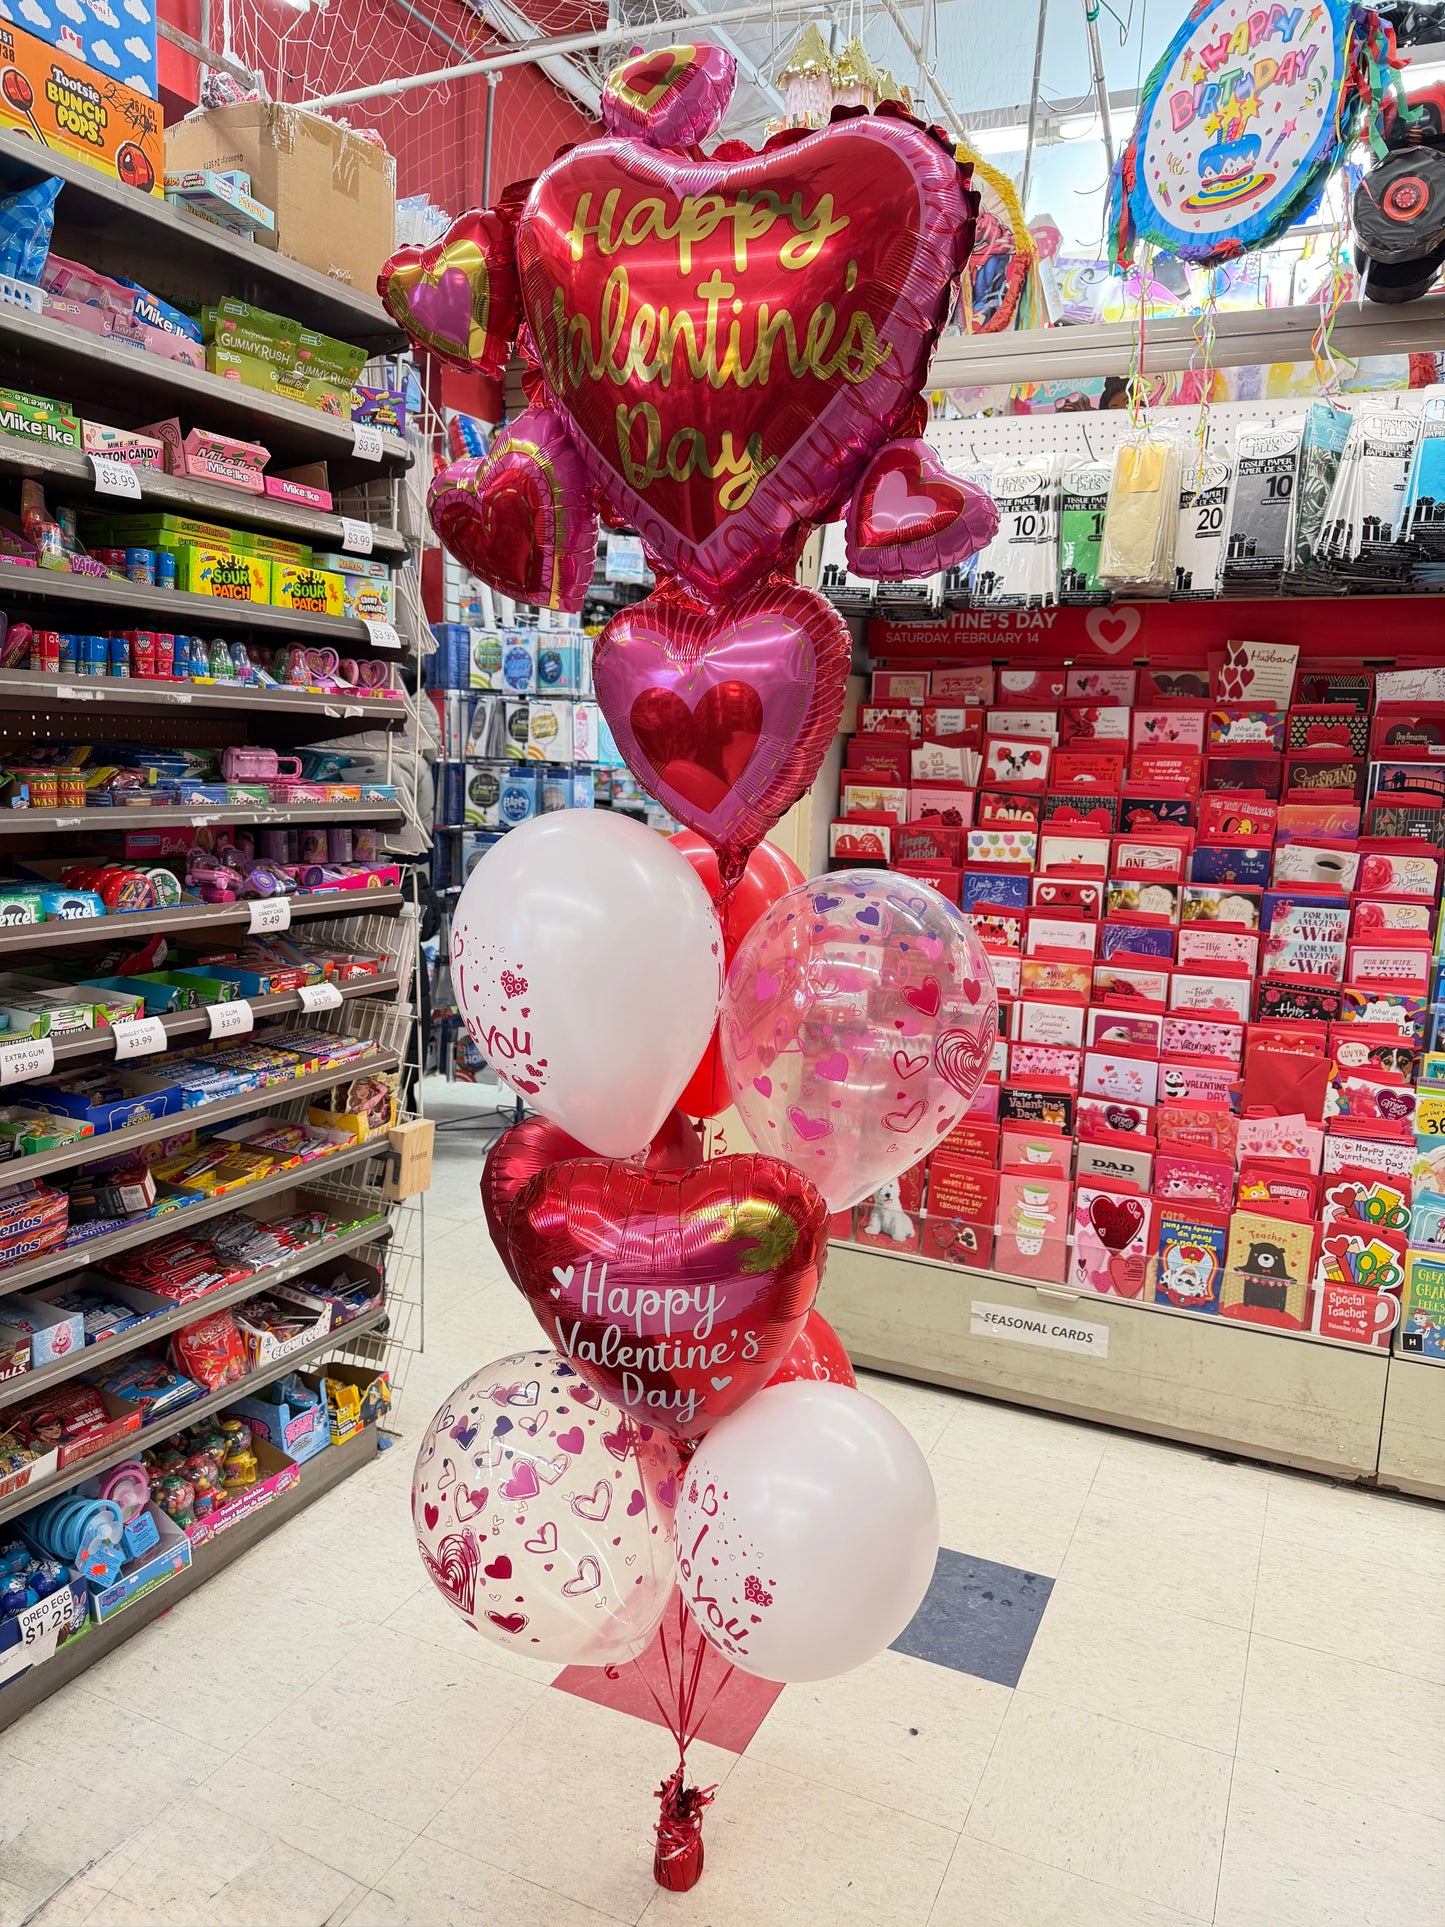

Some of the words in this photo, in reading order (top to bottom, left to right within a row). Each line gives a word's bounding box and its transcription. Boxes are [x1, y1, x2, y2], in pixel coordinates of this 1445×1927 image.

[1199, 3, 1303, 71] HAPPY
[52, 66, 100, 100] Tootsie
[1169, 44, 1318, 131] BIRTHDAY
[47, 81, 107, 126] BUNCH
[57, 105, 98, 142] POPS
[566, 188, 851, 275] Happy
[135, 298, 173, 332] Mike
[221, 333, 260, 354] GUMMY
[261, 346, 291, 364] RUSH
[294, 361, 329, 381] GUMMY
[330, 370, 354, 387] RUSH
[0, 411, 42, 436] Mike
[47, 425, 74, 446] Ike
[1371, 417, 1421, 430] DESIGNS
[1380, 427, 1408, 437] PLUS
[358, 439, 381, 454] $3.99
[1245, 434, 1295, 451] DESIGNS
[1250, 443, 1280, 455] PLUS
[1368, 442, 1396, 451] TISSUE
[128, 448, 160, 460] CANDY
[615, 401, 779, 512] Day
[1240, 459, 1266, 469] TISSUE
[1267, 457, 1294, 466] PAPER
[1261, 466, 1274, 474] DE
[1275, 464, 1295, 472] SOIE
[208, 461, 232, 477] Mike
[234, 468, 250, 482] Ike
[102, 471, 136, 489] $3.99
[997, 474, 1038, 487] DESIGNS
[1076, 482, 1101, 491] PLUS
[1266, 474, 1293, 498] 10
[283, 483, 305, 496] Mike
[307, 488, 320, 502] Ike
[1001, 483, 1025, 493] PLUS
[1014, 498, 1036, 506] PAPER
[1012, 515, 1036, 536] 10
[1197, 507, 1222, 531] 20
[348, 533, 370, 547] $3.99
[213, 568, 249, 585] SOUR
[212, 583, 251, 600] PATCH
[293, 583, 326, 598] SOUR
[292, 598, 327, 613] PATCH
[1016, 612, 1058, 629] DAY
[373, 629, 395, 641] $3.99
[885, 632, 951, 644] SATURDAY,
[953, 632, 1023, 643] FEBRUARY
[1026, 632, 1039, 643] 14
[1251, 650, 1296, 665] Husband
[1125, 858, 1146, 868] ONE
[1390, 873, 1431, 886] Woman
[0, 905, 35, 927] excel
[262, 915, 280, 926] 3.49
[1303, 911, 1321, 919] FOR
[1296, 919, 1342, 928] AMAZING
[1293, 926, 1342, 942] Wife
[1320, 945, 1335, 953] MY
[1293, 952, 1338, 961] AMAZING
[1289, 959, 1339, 975] Wife
[313, 995, 332, 1006] $3.99
[226, 1008, 239, 1017] GUM
[221, 1016, 241, 1029] $3.99
[129, 1035, 153, 1048] $3.99
[5, 1052, 27, 1062] EXTRA
[28, 1049, 45, 1058] GUM
[1340, 1050, 1354, 1058] LUV
[14, 1061, 39, 1074] $3.99
[1185, 1080, 1227, 1091] VALENTINE
[1207, 1092, 1226, 1101] DAY
[1180, 1132, 1209, 1140] Mother
[1355, 1143, 1384, 1157] Happy
[1334, 1150, 1383, 1165] Valentine's
[1091, 1159, 1135, 1173] DAD
[1170, 1168, 1214, 1182] Grandma
[1269, 1185, 1309, 1199] GRANDPARENTS
[1160, 1209, 1186, 1223] CATS
[0, 1213, 42, 1237] entos
[1248, 1230, 1288, 1244] Teacher
[0, 1238, 39, 1261] entos
[581, 1261, 727, 1340] Happy
[1329, 1293, 1365, 1307] Special
[1327, 1305, 1368, 1319] Teacher
[984, 1312, 1048, 1335] SEASONAL
[1051, 1322, 1095, 1343] CARDS
[1328, 1322, 1355, 1333] Valentine's
[1355, 1327, 1365, 1335] Day
[272, 1340, 299, 1360] BLOW
[301, 1326, 321, 1346] POP
[555, 1316, 766, 1373] Valentine's
[622, 1371, 706, 1424] Day
[220, 1499, 243, 1516] Gumball
[243, 1487, 265, 1504] Machine
[22, 1605, 49, 1627] OREO
[51, 1590, 71, 1609] EGG
[25, 1603, 73, 1645] $1.25
